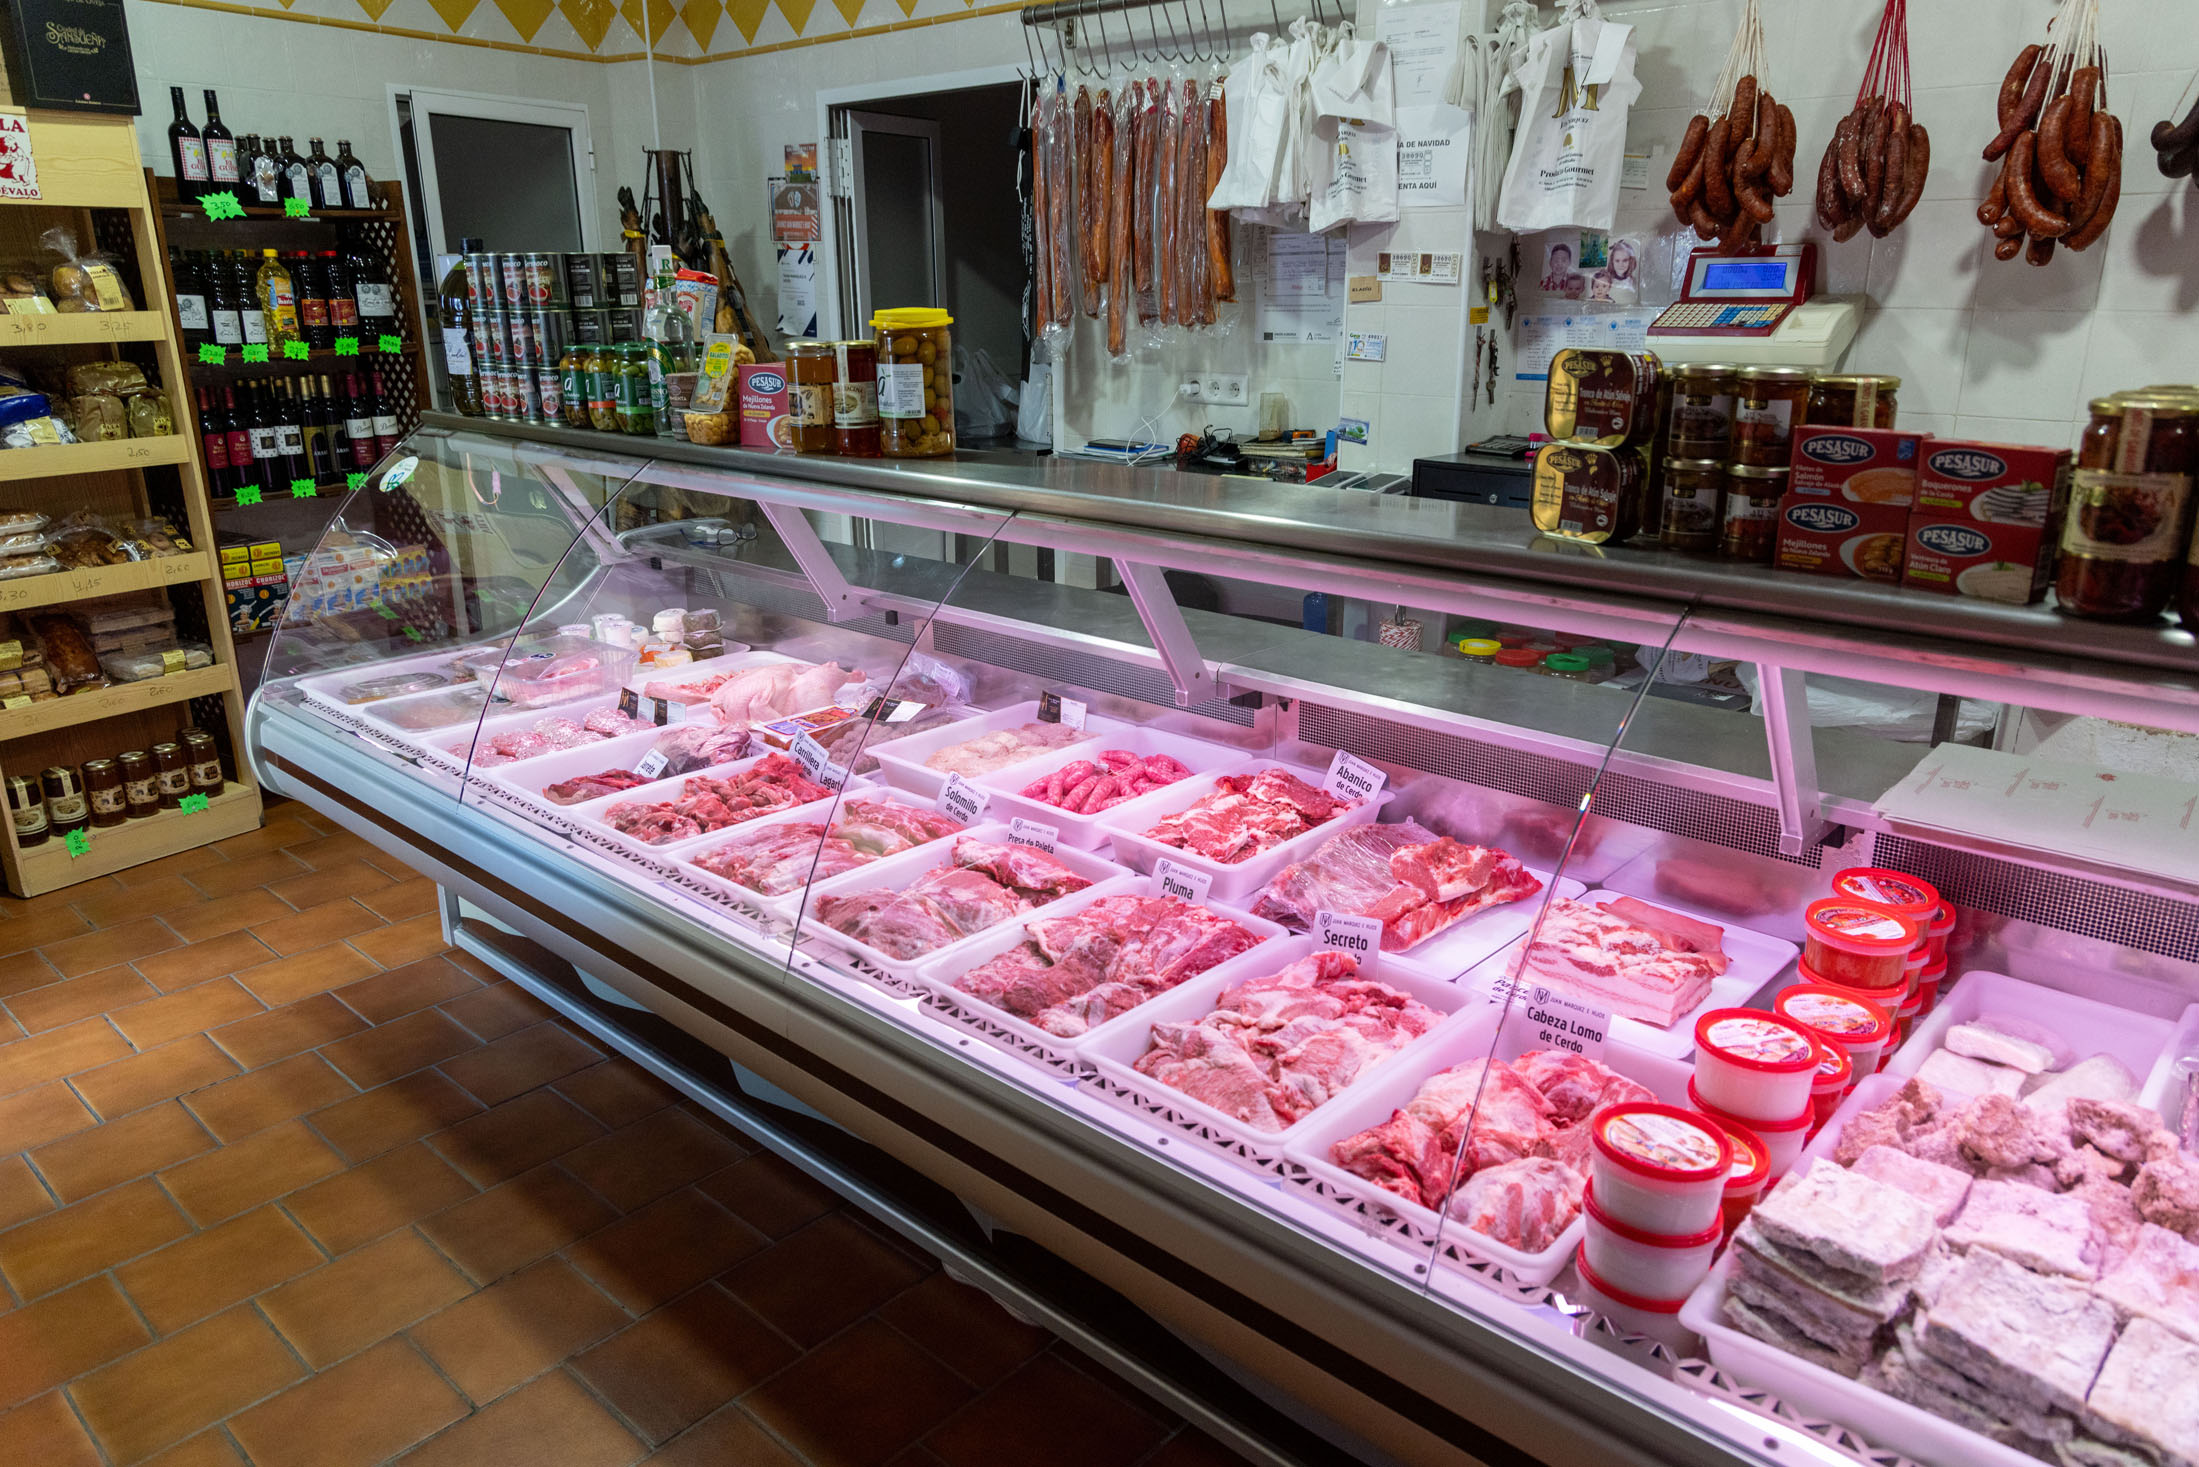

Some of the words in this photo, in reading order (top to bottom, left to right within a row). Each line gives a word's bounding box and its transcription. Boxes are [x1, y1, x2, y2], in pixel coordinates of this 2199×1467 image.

[1417, 139, 1451, 148] NAVIDAD
[0, 186, 38, 197] ÉVALO
[751, 376, 782, 388] PESASUR
[742, 394, 772, 405] Mejillones
[1807, 440, 1869, 457] PESASUR
[1934, 454, 2001, 474] PESASUR
[1795, 471, 1825, 482] Salmón
[1922, 479, 1973, 494] Boquerones
[1791, 507, 1854, 526] PESASUR
[1782, 538, 1828, 551] Mejillones
[1922, 529, 1985, 550] PESASUR
[1909, 560, 1928, 571] Atún
[1928, 562, 1952, 574] Claro
[227, 578, 254, 590] HORIZOL
[256, 573, 286, 585] CHORIZOL
[794, 741, 820, 771] Carrillera
[1336, 765, 1373, 793] Abanico
[1336, 780, 1345, 791] de
[945, 785, 978, 815] Solomillo
[945, 802, 954, 812] de
[953, 806, 969, 822] Cerdo
[1008, 832, 1025, 845] Presa
[1026, 837, 1035, 847] de
[1162, 876, 1195, 901] Pluma
[1323, 929, 1369, 951] Secreto
[1527, 1005, 1568, 1031] Cabeza
[1569, 1020, 1604, 1043] Lomo
[1539, 1029, 1552, 1043] de
[1554, 1034, 1584, 1054] Cerdo
